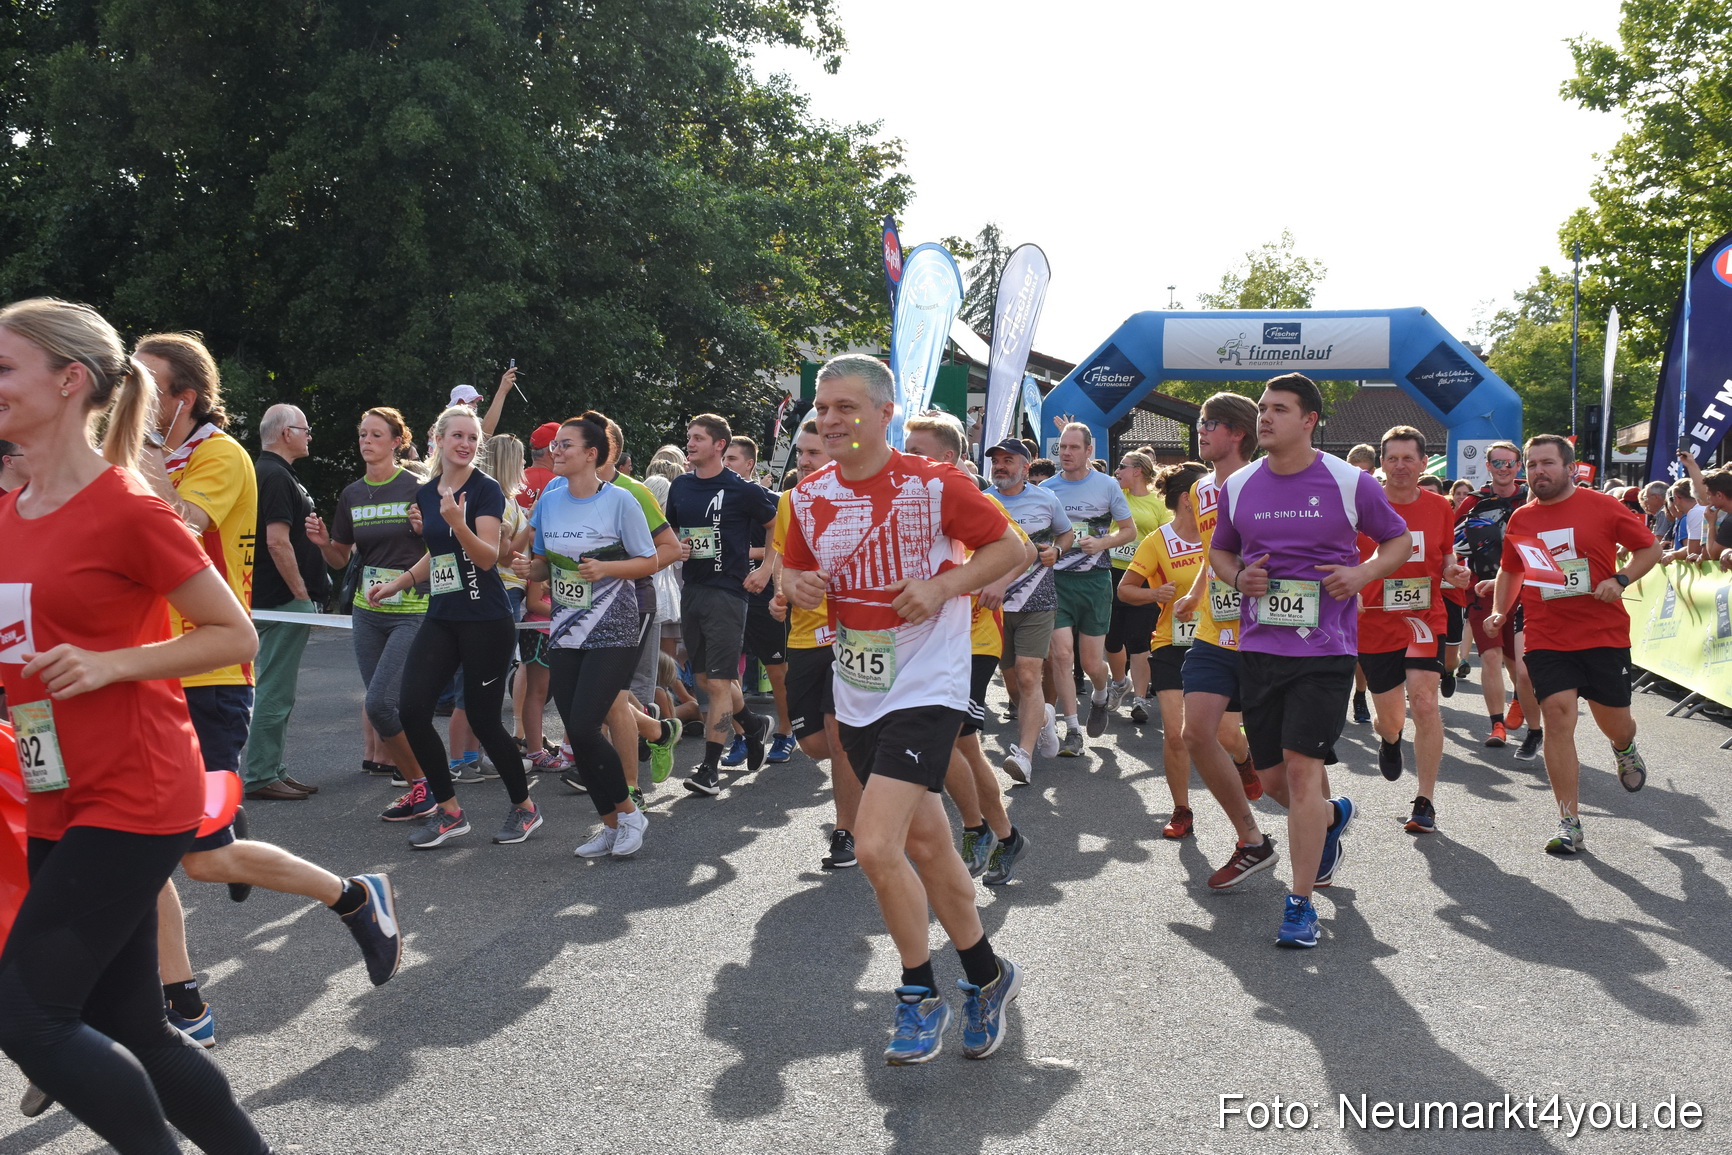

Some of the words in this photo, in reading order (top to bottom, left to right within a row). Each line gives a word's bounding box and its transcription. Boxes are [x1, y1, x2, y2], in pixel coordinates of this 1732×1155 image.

[1007, 264, 1035, 337] Fischer
[1271, 329, 1299, 338] Fischer
[1249, 344, 1334, 361] firmenlauf
[1091, 372, 1135, 383] Fischer
[352, 502, 407, 520] BOCK
[1254, 511, 1271, 520] WIR
[1273, 510, 1297, 519] SIND
[1299, 510, 1323, 518] LILA.
[1171, 557, 1197, 570] MAX
[432, 567, 455, 585] 1944
[553, 579, 584, 599] 1929
[1394, 589, 1421, 603] 554
[1211, 592, 1241, 610] 1645
[1268, 595, 1304, 613] 904
[838, 643, 885, 675] 2215
